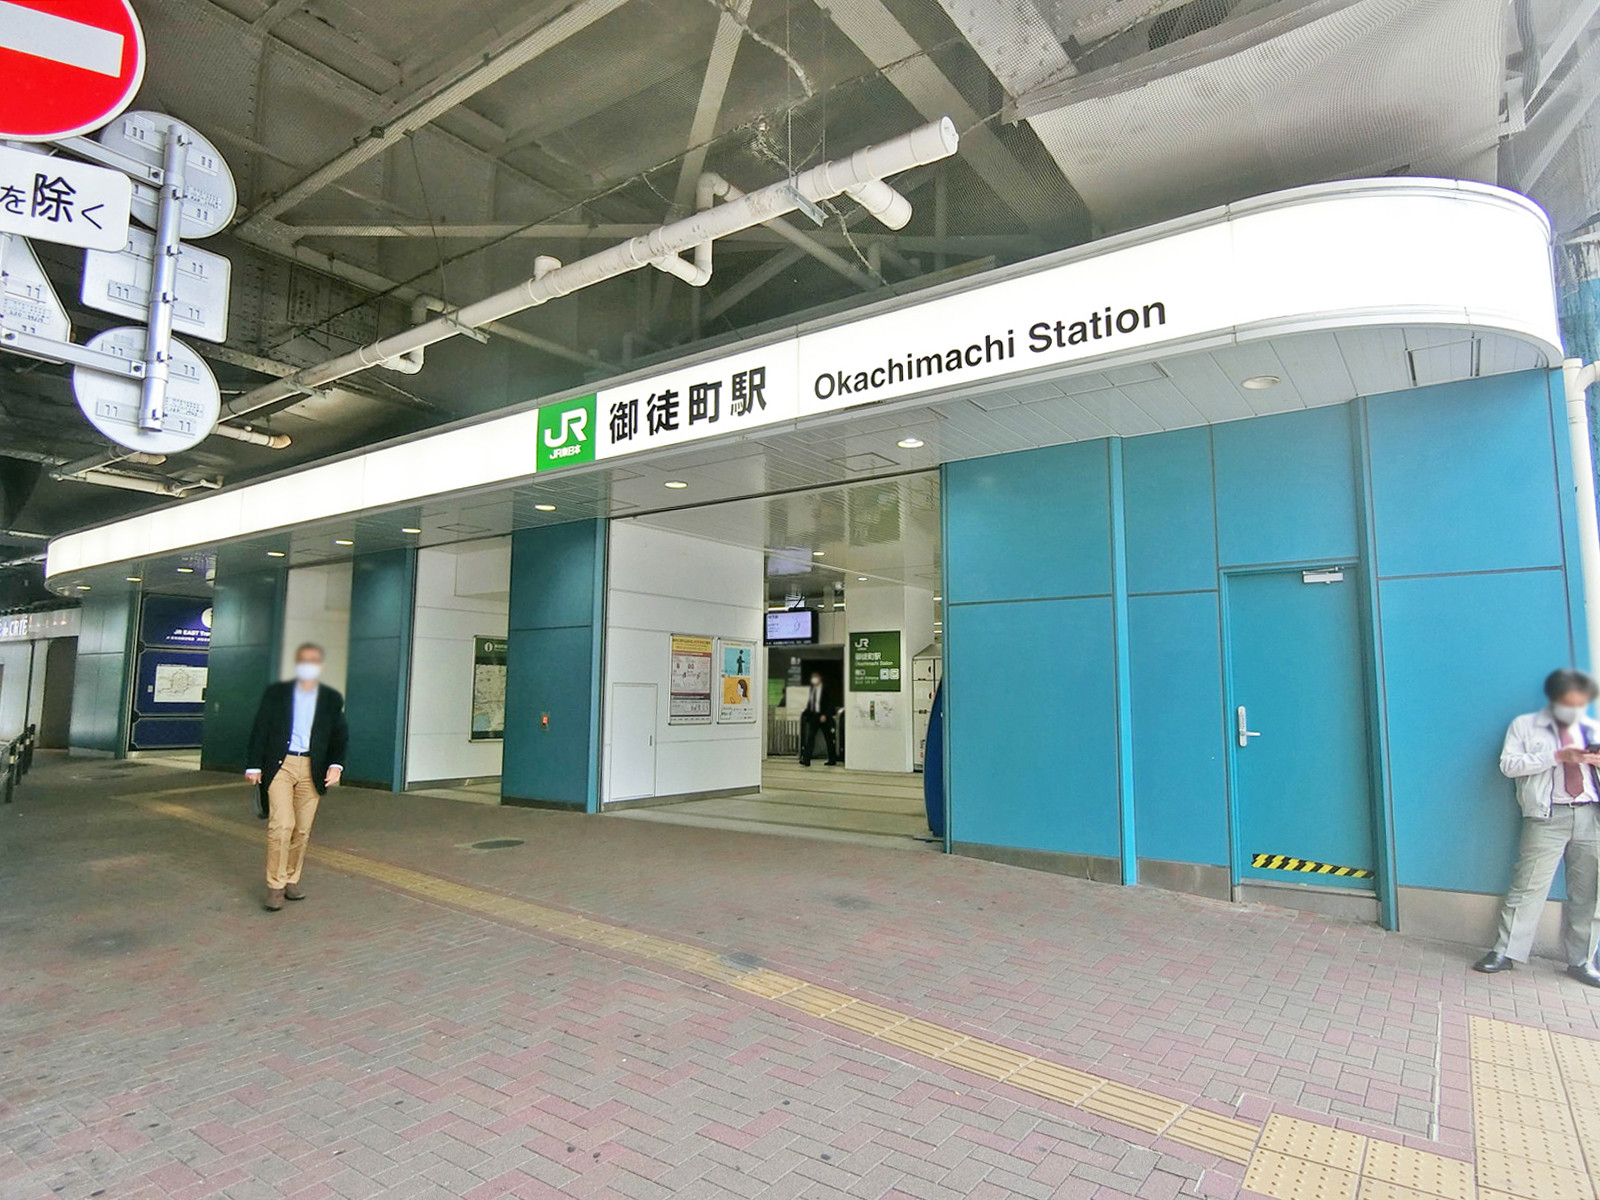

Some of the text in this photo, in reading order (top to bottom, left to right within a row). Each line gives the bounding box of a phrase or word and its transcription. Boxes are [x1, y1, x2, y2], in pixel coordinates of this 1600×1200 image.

[0, 173, 104, 230] を除く
[814, 301, 1166, 400] Okachimachi Station
[544, 407, 588, 448] JR
[609, 366, 767, 444] 御徒町駅
[549, 444, 582, 459] JR東日本
[854, 638, 869, 648] JR
